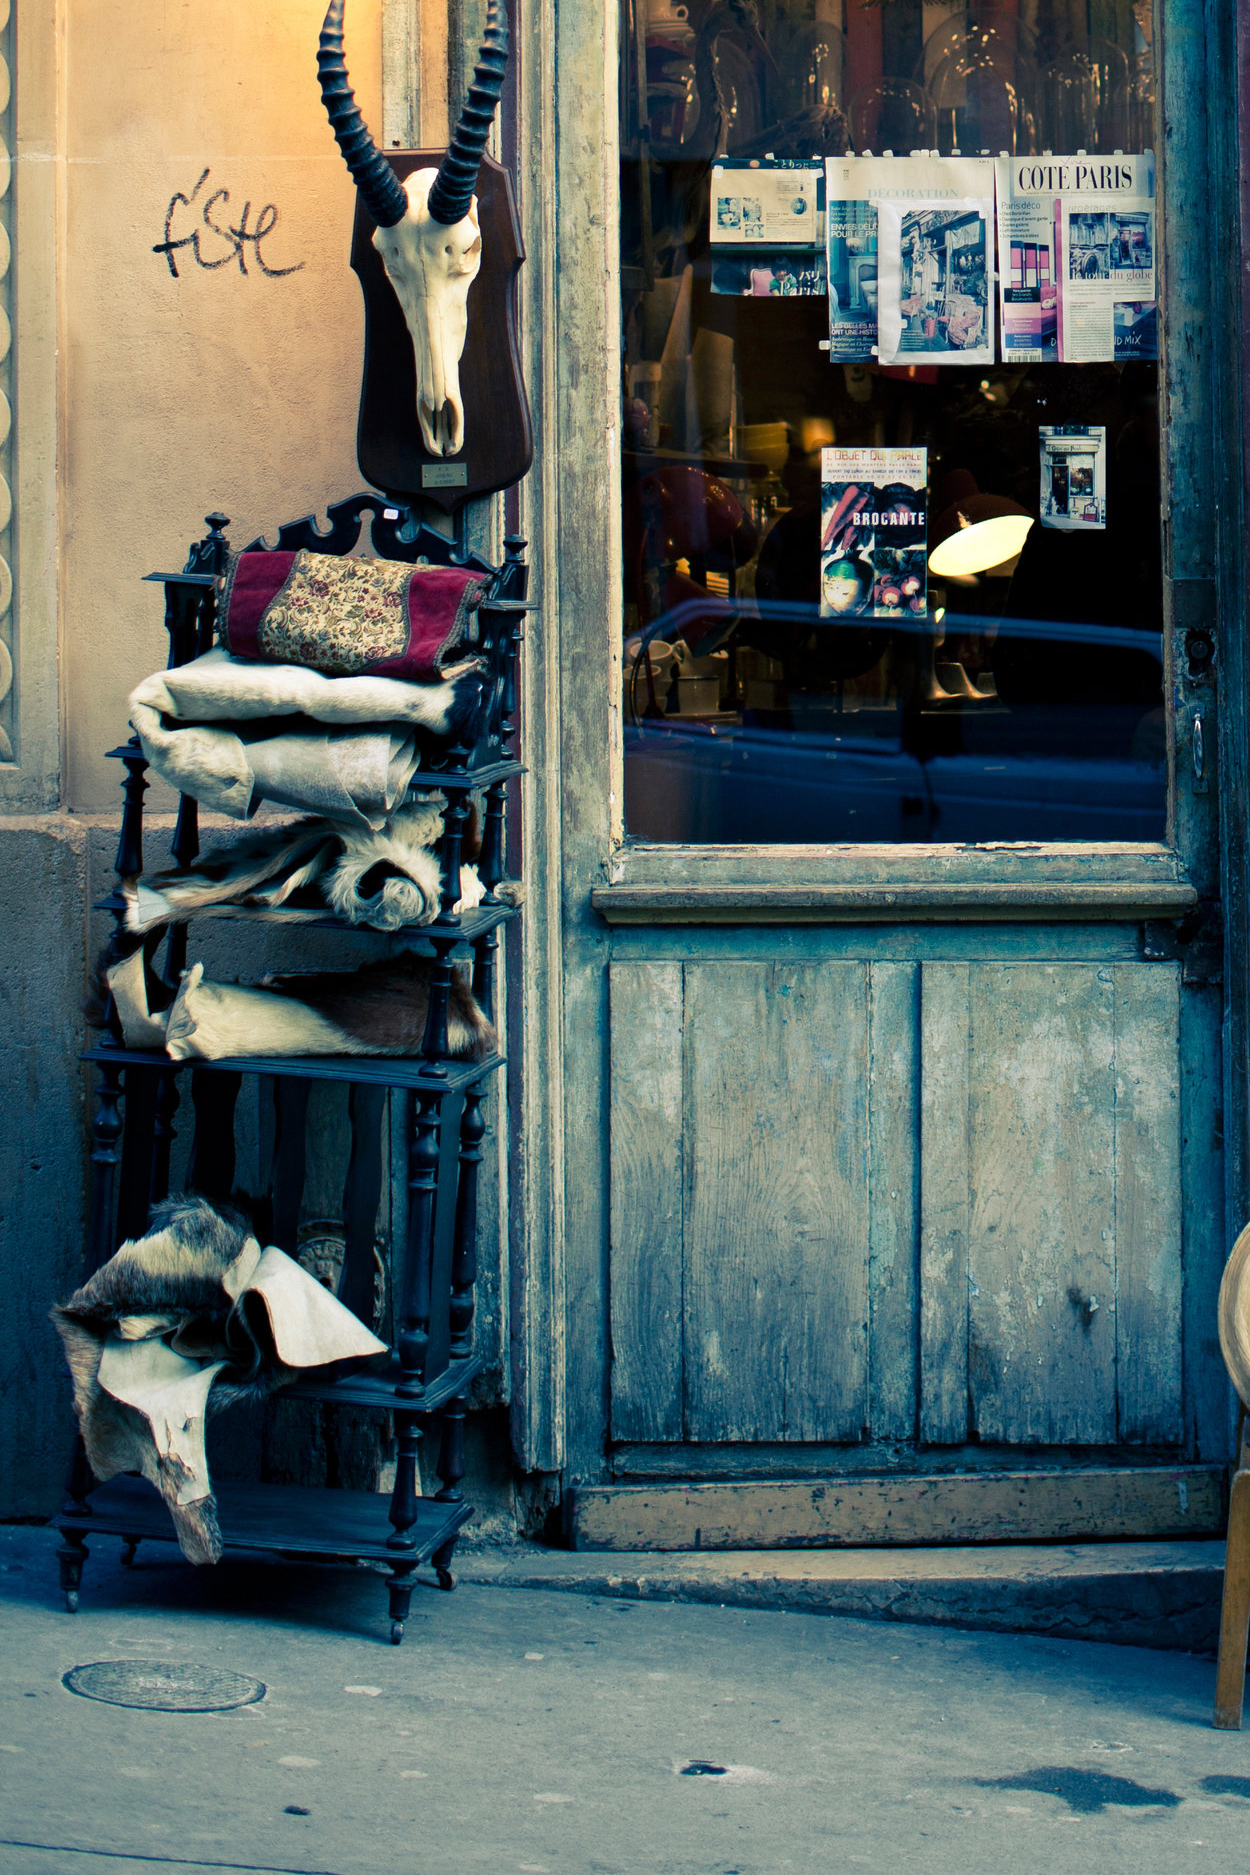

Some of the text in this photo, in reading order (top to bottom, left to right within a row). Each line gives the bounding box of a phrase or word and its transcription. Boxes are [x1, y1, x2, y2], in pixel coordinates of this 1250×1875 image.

[1075, 165, 1132, 190] PARIS
[1110, 268, 1123, 279] du
[1126, 268, 1153, 282] globe
[853, 512, 925, 526] BROCANTE
